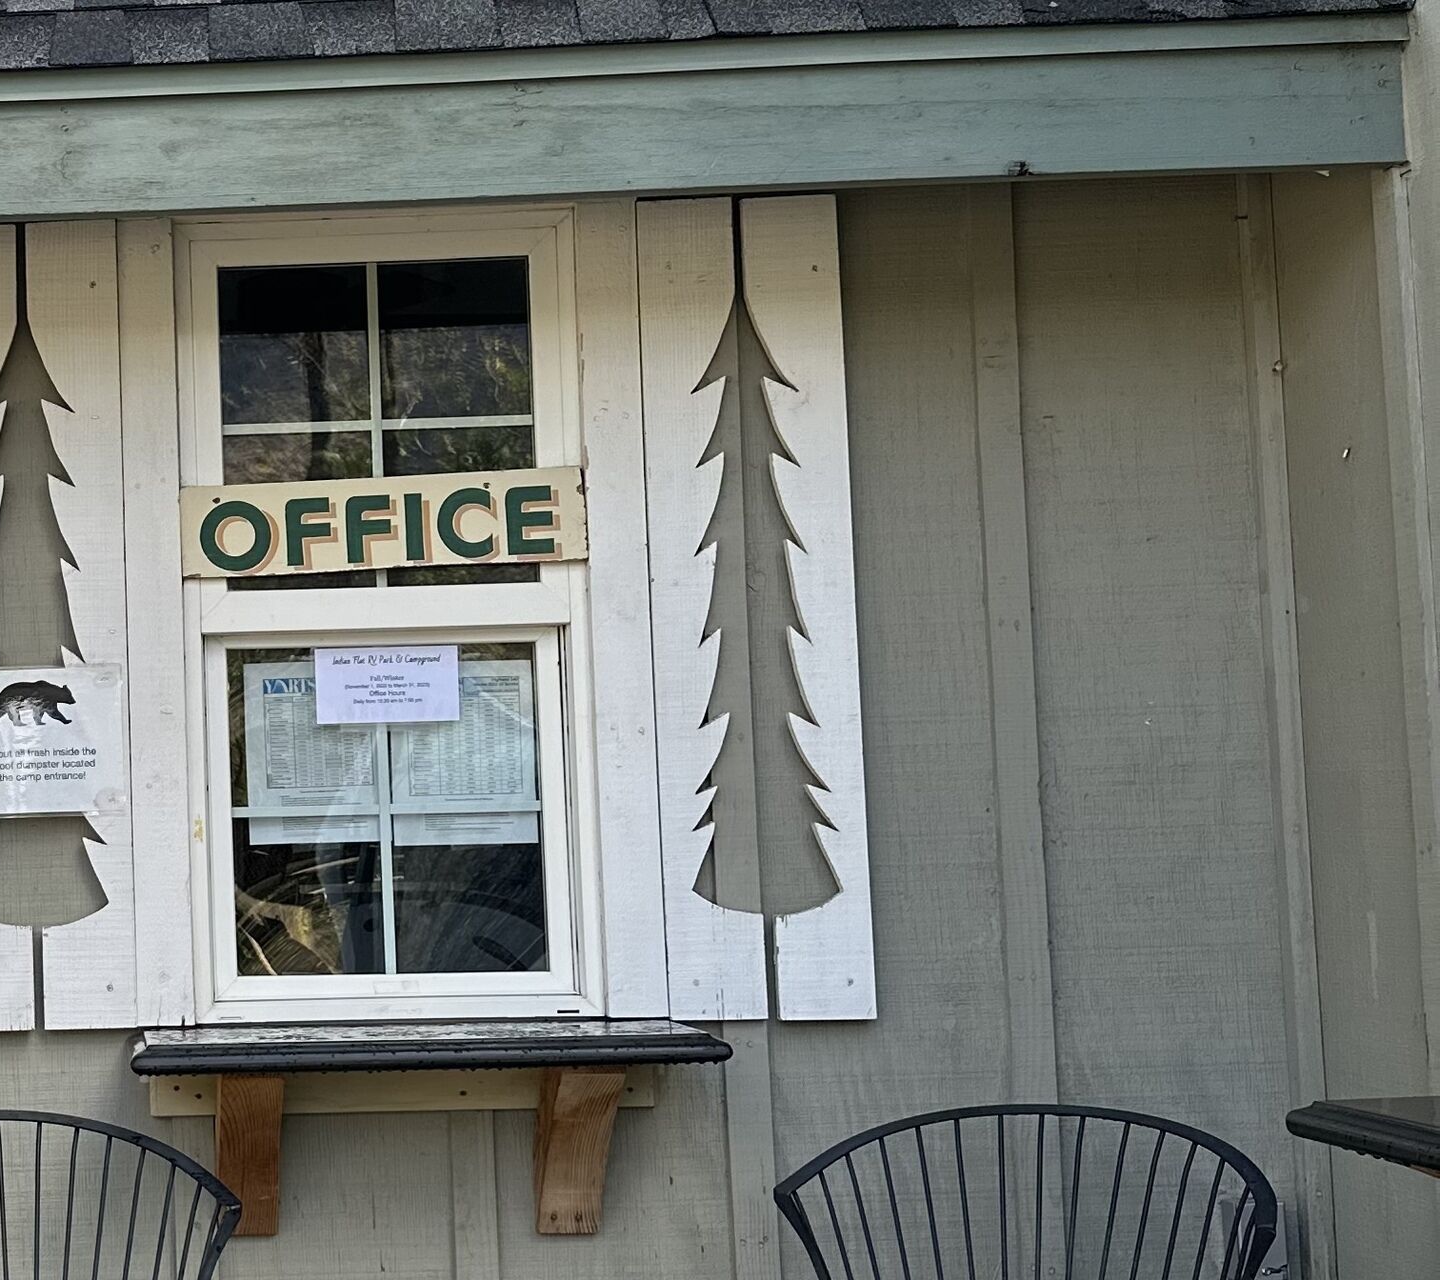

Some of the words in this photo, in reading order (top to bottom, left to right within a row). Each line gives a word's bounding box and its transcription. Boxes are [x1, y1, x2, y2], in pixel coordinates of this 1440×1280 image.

[200, 485, 559, 573] OFFICE
[367, 654, 378, 666] RV
[378, 654, 394, 664] Park
[404, 653, 441, 666] Campground
[27, 748, 50, 758] trash
[53, 747, 80, 757] inside
[82, 746, 97, 756] the
[16, 759, 60, 770] dumpster
[62, 758, 96, 768] located
[0, 773, 13, 782] the
[15, 772, 42, 783] camp
[44, 770, 87, 781] entrance!
